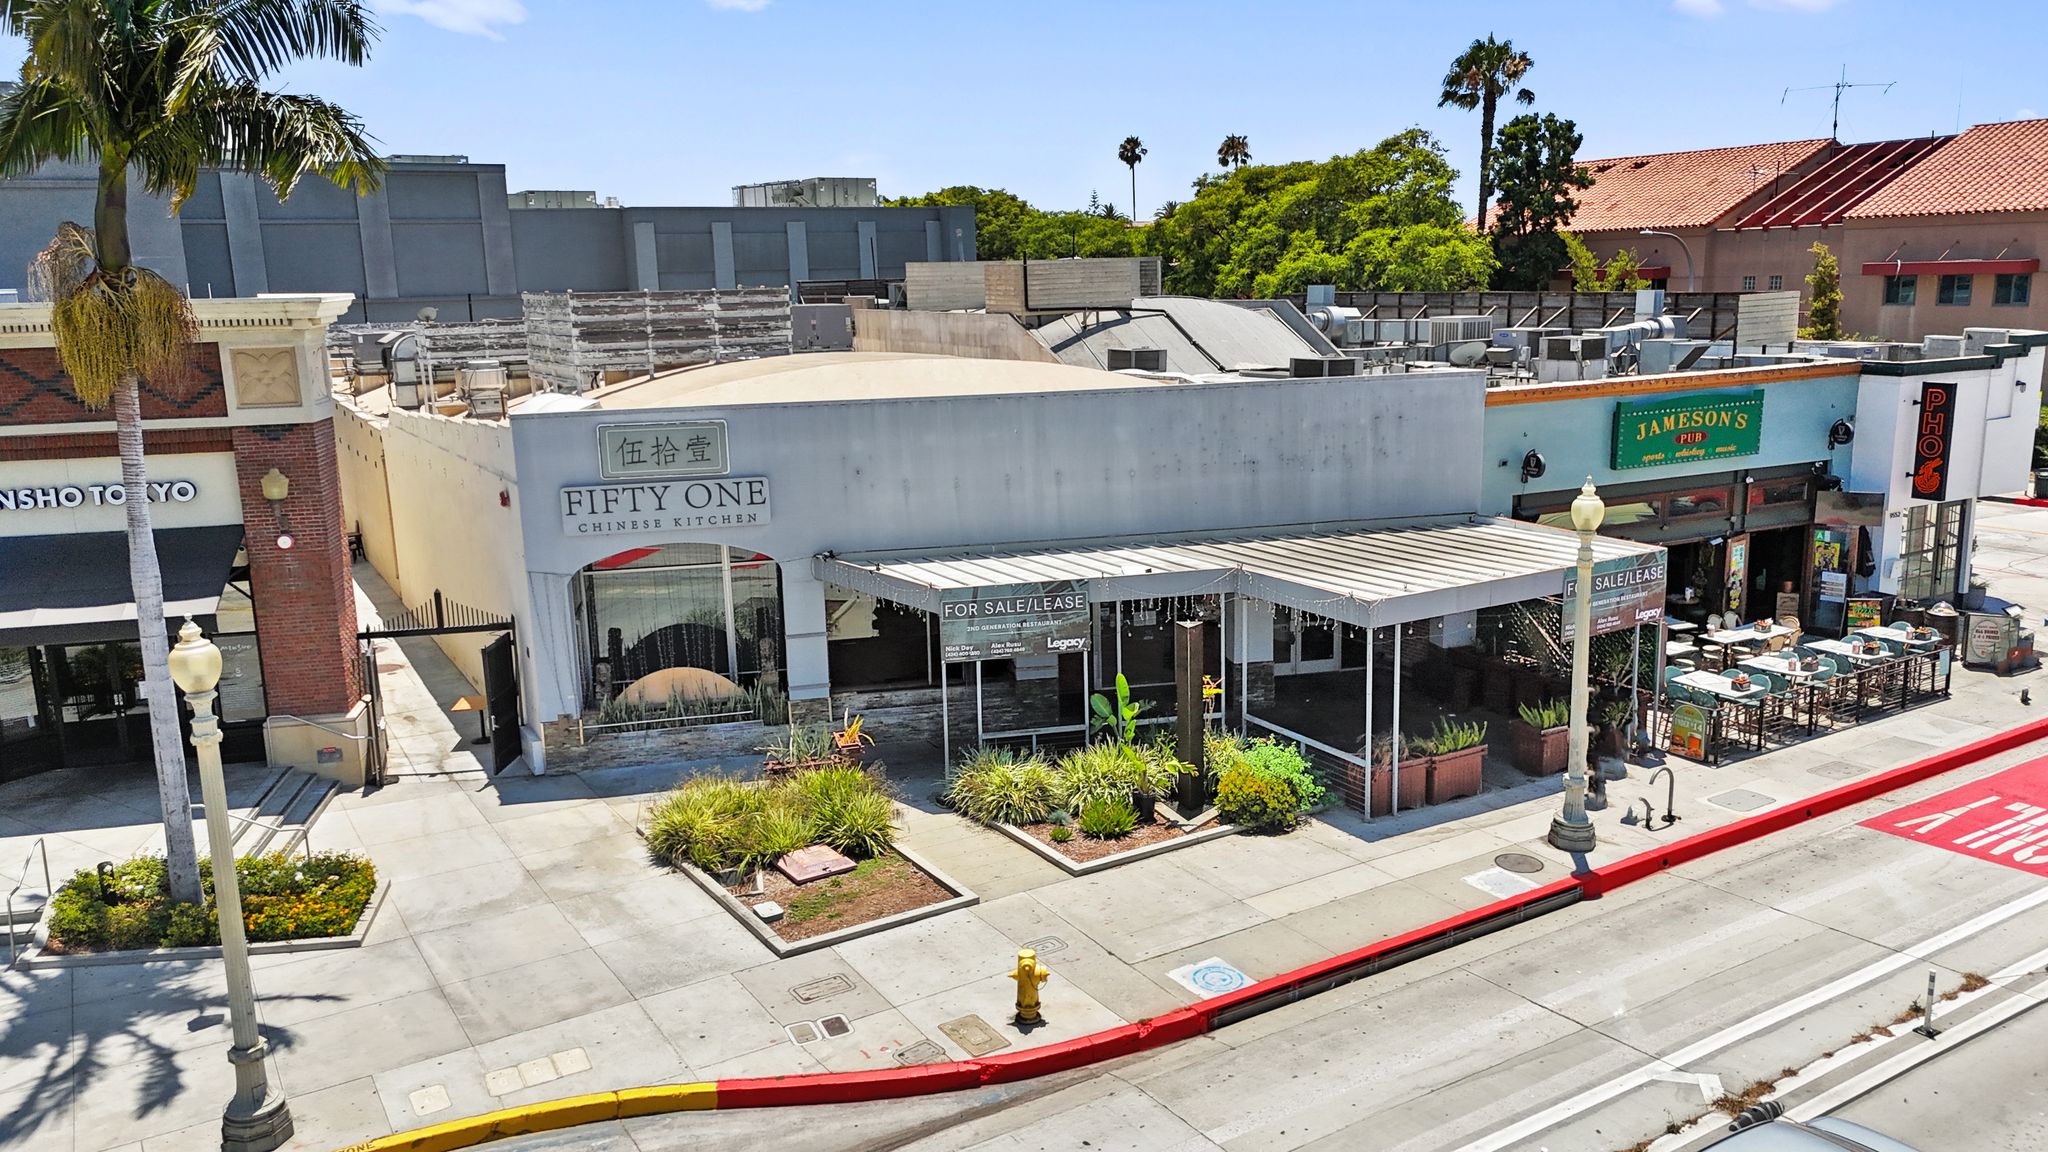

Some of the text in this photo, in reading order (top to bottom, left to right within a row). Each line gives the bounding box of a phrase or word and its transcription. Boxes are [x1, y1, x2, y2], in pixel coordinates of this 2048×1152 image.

[1637, 409, 1748, 440] JAMESON'S
[1919, 388, 1946, 458] PHO
[1680, 433, 1702, 444] PUB
[616, 434, 711, 467] 伍拾壹
[1642, 452, 1665, 463] sports
[1715, 444, 1737, 453] music
[88, 481, 196, 506] TOYO
[564, 480, 767, 517] FIFTY ONE
[578, 513, 758, 533] CHINESE KITCHEN
[1816, 531, 1824, 540] A
[1595, 566, 1664, 591] SALE/LEASE
[945, 595, 1084, 617] FOR SALE/LEASE
[1634, 607, 1662, 621] Legacy
[981, 622, 1021, 631] GENERATION
[1022, 619, 1062, 628] RESTAURANT
[1047, 636, 1086, 650] Legacy
